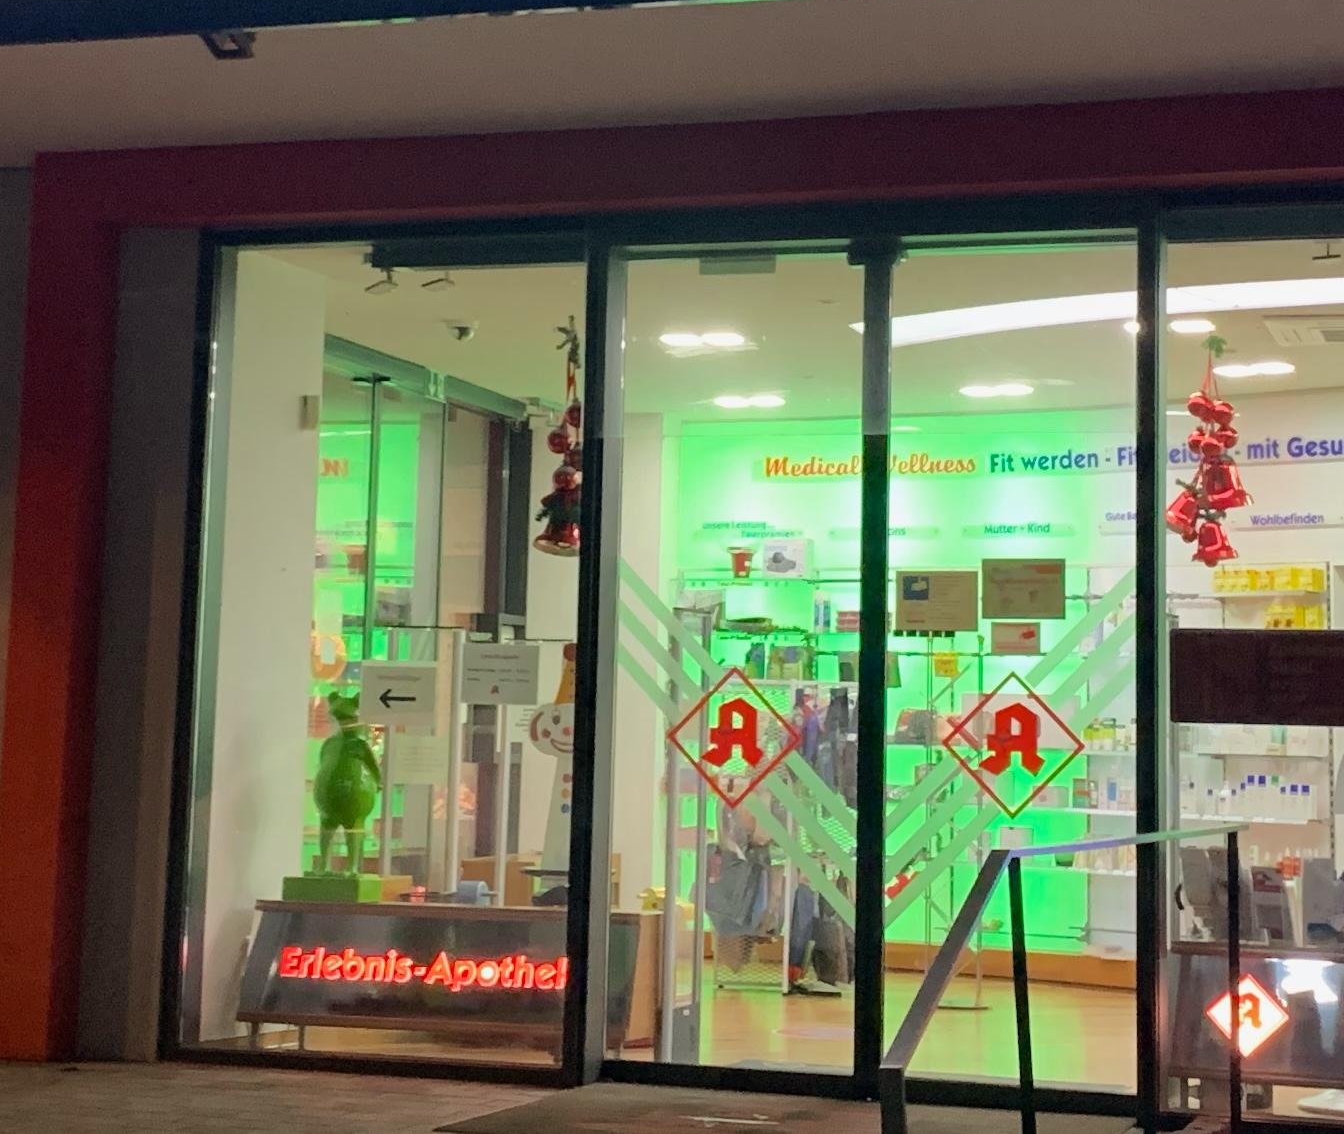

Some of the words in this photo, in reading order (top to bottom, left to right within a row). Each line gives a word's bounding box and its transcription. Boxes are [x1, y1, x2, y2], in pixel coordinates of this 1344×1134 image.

[990, 452, 1015, 473] Fit
[1020, 448, 1099, 471] werden
[1116, 446, 1137, 467] Fi
[1247, 437, 1280, 460] mit
[764, 454, 863, 478] Medical
[888, 452, 976, 475] ellness
[1027, 522, 1051, 534] Kind
[1250, 513, 1324, 526] Wohlbefinden
